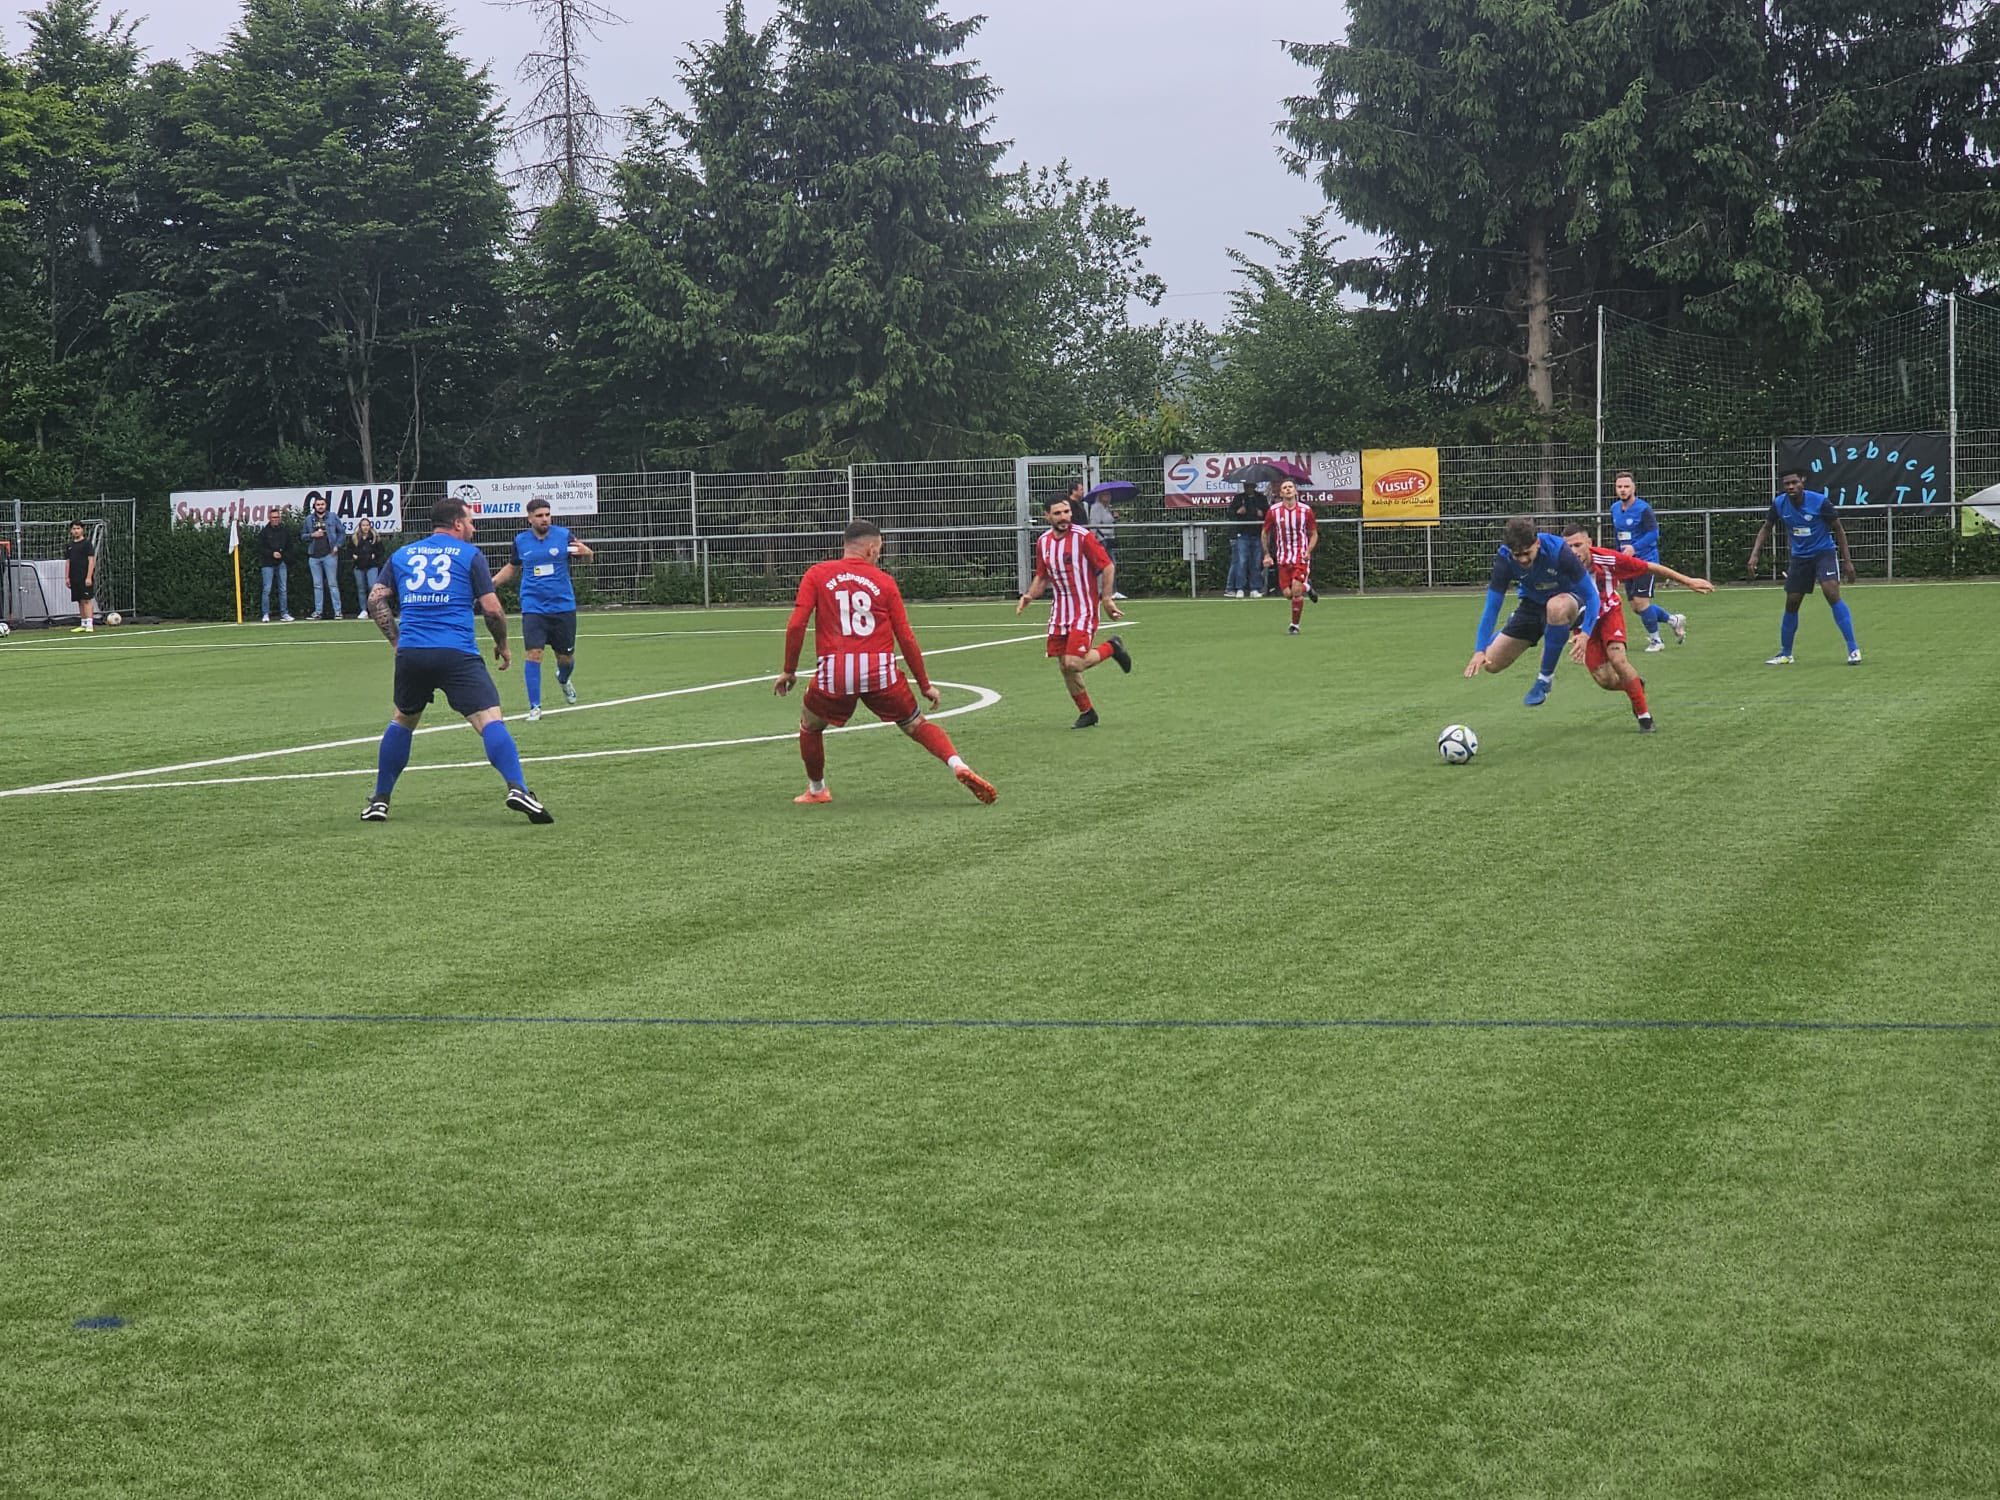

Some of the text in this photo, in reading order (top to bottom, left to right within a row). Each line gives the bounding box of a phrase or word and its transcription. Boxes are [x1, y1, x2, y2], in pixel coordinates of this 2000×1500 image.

[1318, 453, 1356, 470] Estrich
[1327, 466, 1352, 479] aller
[1811, 440, 1935, 483] ulzbach
[1334, 477, 1352, 488] Art
[1823, 484, 1936, 505] lik TV
[176, 498, 292, 526] Sporthau
[483, 502, 521, 514] WALTER
[405, 554, 452, 591] 33
[825, 572, 881, 597] SV Schnappach
[835, 590, 876, 637] 18
